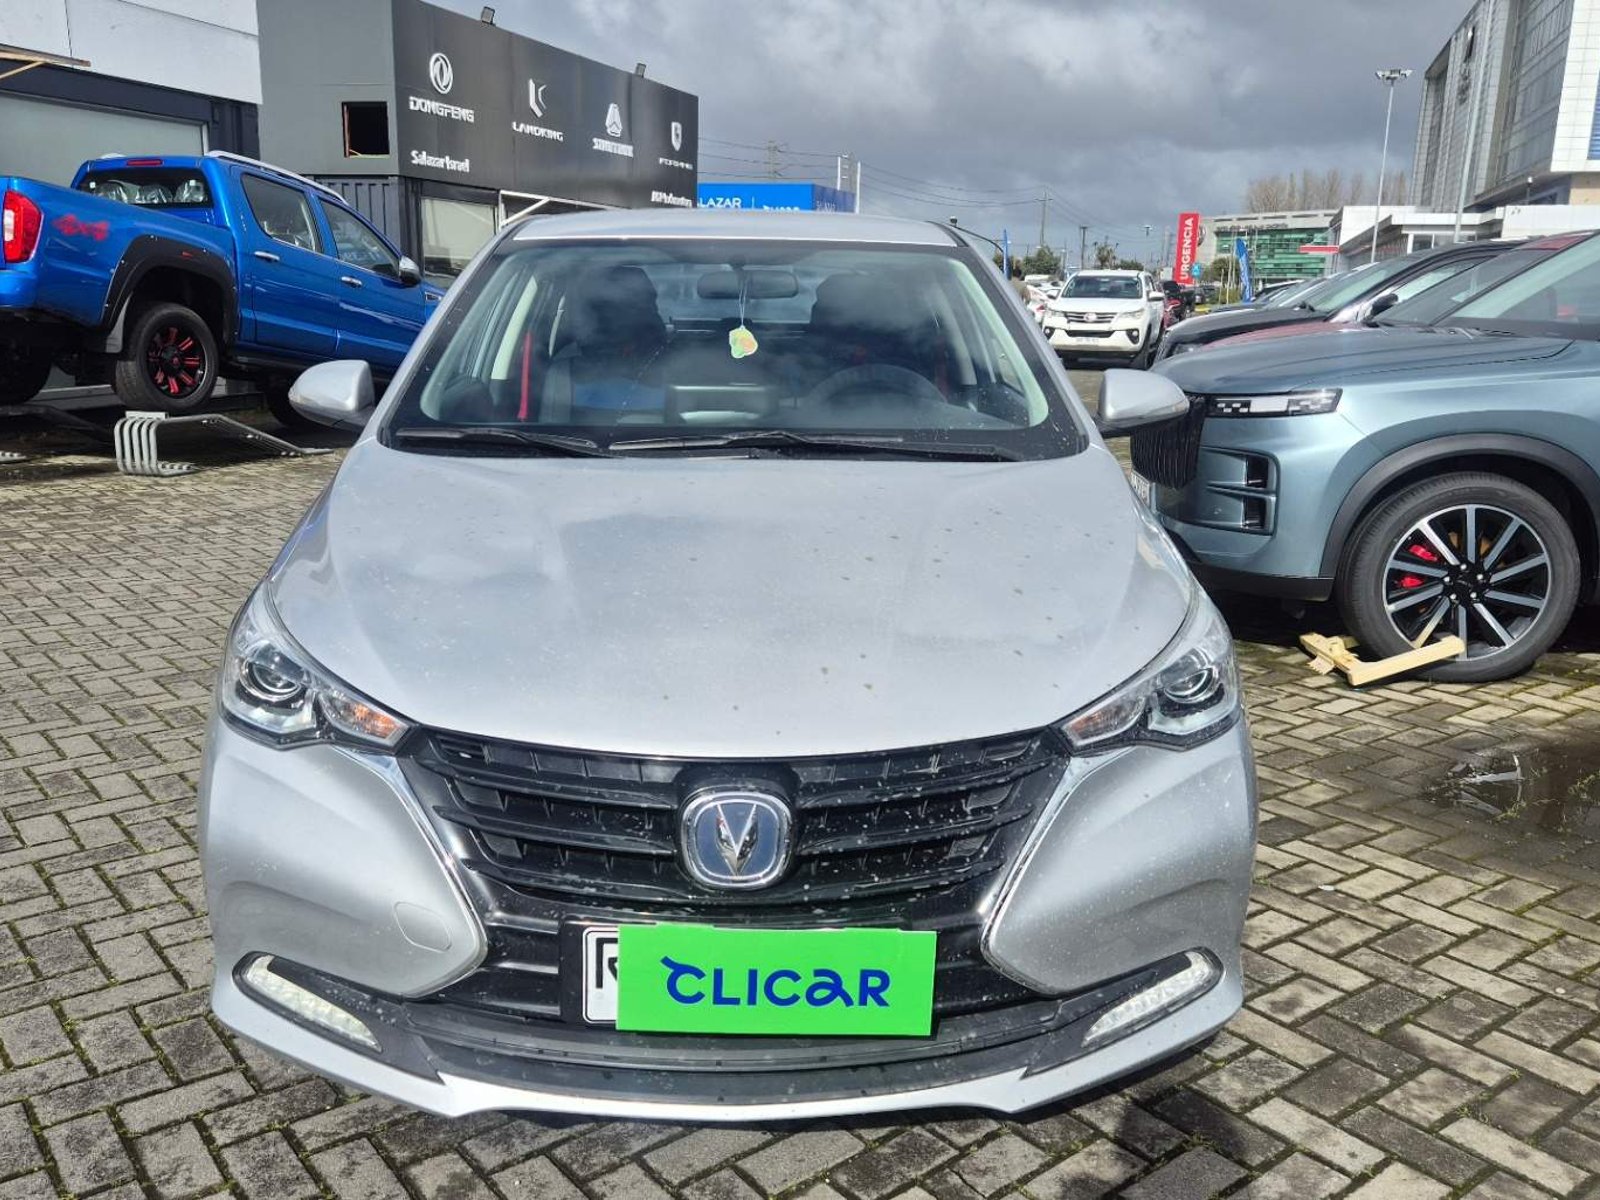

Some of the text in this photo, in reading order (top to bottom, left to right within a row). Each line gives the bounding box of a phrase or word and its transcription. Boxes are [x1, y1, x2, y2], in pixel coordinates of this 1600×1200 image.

[409, 96, 475, 123] DONGFENG
[512, 121, 564, 142] LANDKING
[697, 197, 742, 208] LAZAR
[1179, 217, 1194, 280] URGENCIA
